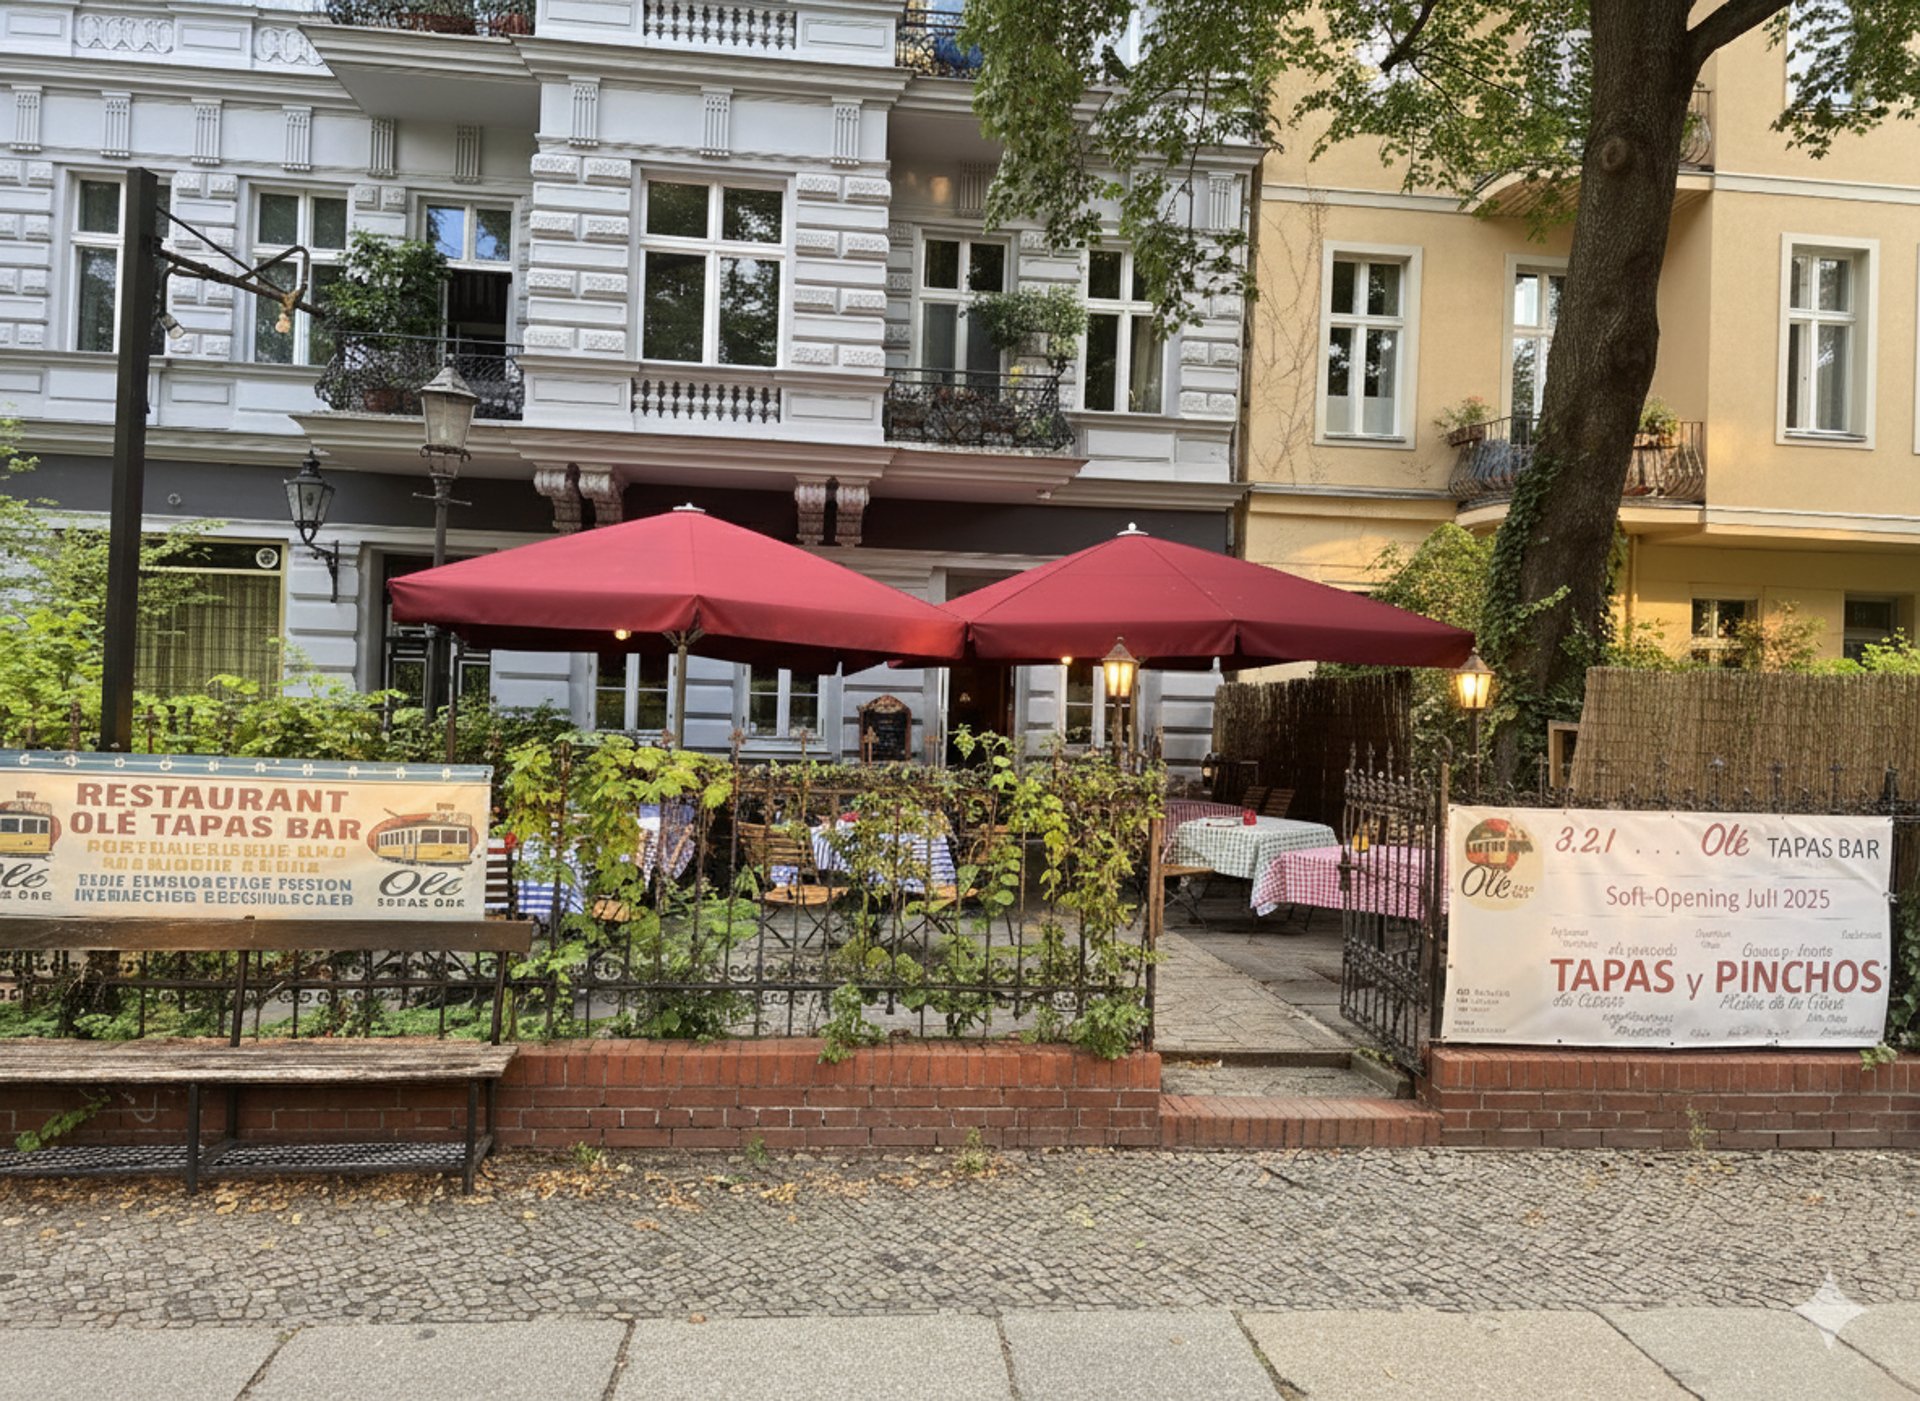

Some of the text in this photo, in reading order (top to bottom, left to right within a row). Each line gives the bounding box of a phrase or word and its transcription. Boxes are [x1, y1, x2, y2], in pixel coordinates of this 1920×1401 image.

[77, 784, 349, 813] RESTAURANT
[151, 814, 273, 838] TAPAS
[287, 817, 361, 840] BAR
[1767, 837, 1833, 859] TAPAS
[1838, 839, 1880, 860] BAR
[1606, 885, 1741, 912] Soft-Opening
[1783, 889, 1830, 909] 2025
[1550, 958, 1883, 1001] TAPAS y PINCHOS
